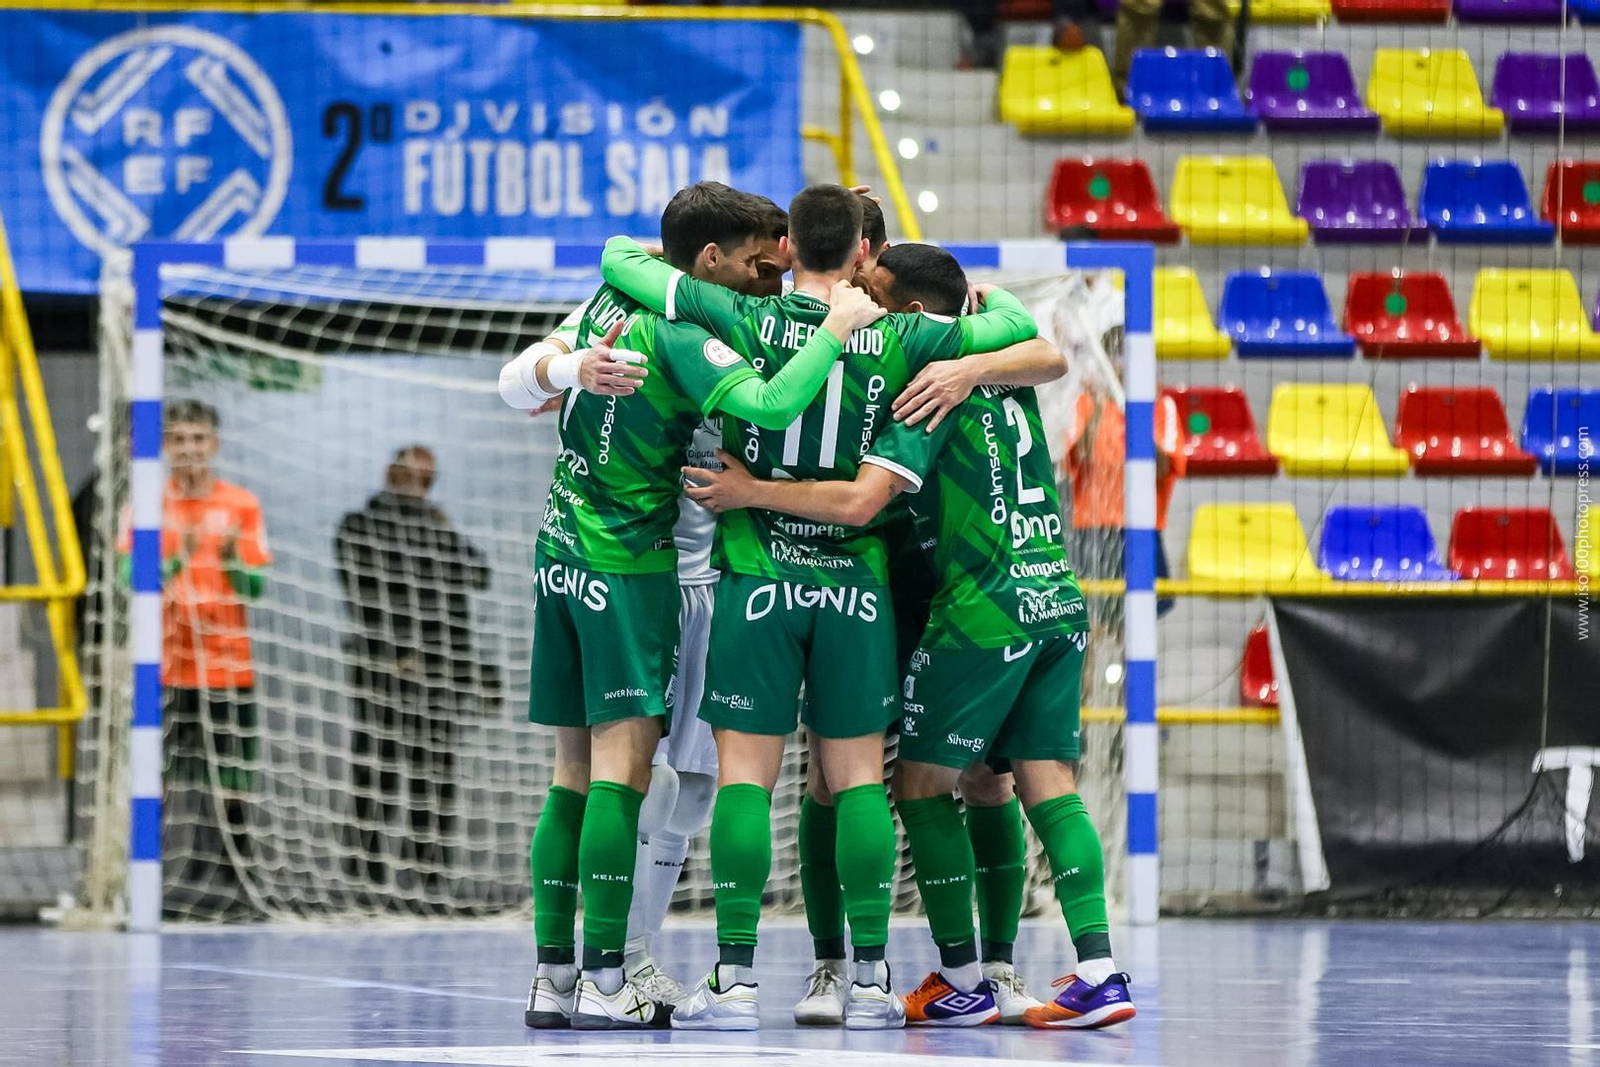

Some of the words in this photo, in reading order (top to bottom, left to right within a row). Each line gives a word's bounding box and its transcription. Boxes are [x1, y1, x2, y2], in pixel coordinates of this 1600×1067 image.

[404, 97, 730, 137] DIVISIÓN
[404, 127, 593, 217] FÚTBOL
[1002, 396, 1045, 504] 2
[540, 564, 610, 612] IGNIS
[783, 582, 877, 622] IGNIS
[946, 733, 985, 753] Silverg
[592, 873, 629, 883] KELME
[925, 874, 969, 885] KELME
